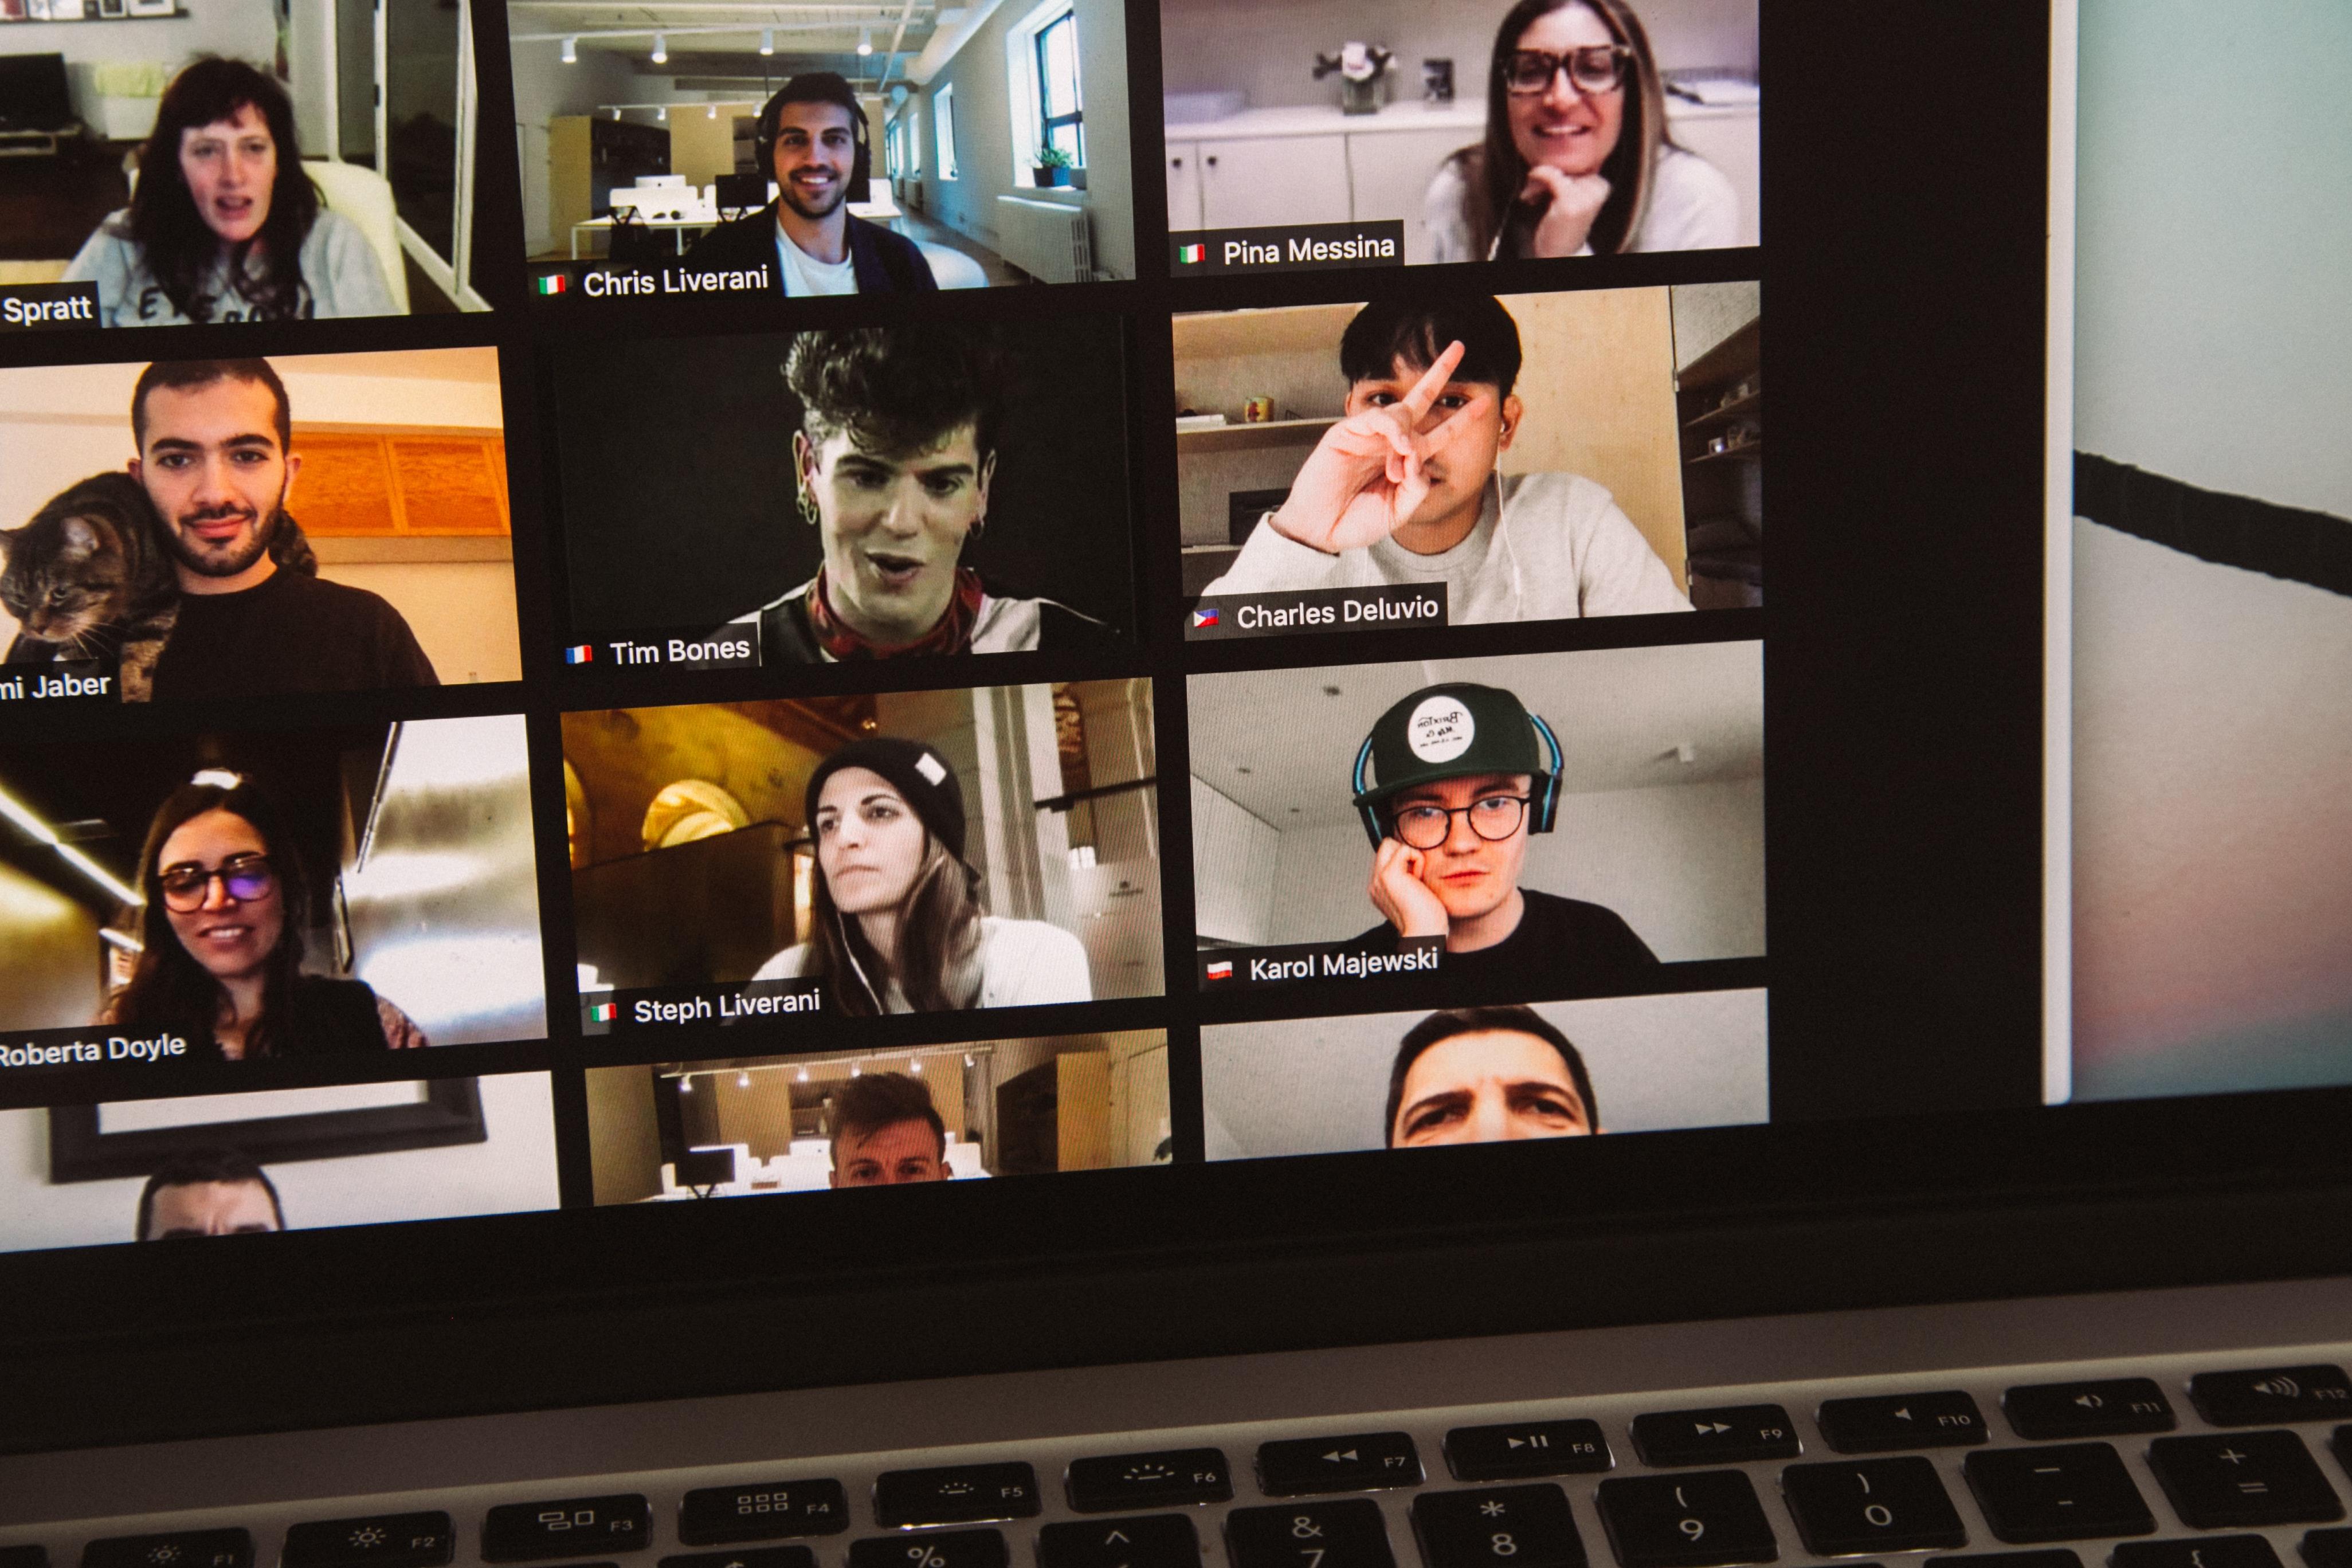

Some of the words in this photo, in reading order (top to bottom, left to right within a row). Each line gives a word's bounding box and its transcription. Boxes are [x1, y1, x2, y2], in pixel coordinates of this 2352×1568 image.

[1224, 240, 1280, 265] Pina
[1288, 234, 1395, 262] Messina
[583, 269, 656, 297] Chris
[663, 264, 769, 293] Liverani
[2, 296, 93, 327] Spratt
[1237, 602, 1335, 629] Charles
[1343, 595, 1438, 622] Deluvio
[609, 641, 660, 665] Tim
[668, 640, 750, 662] Bones
[31, 672, 111, 699] Jaber
[1251, 954, 1315, 981] Karol
[1323, 946, 1438, 978] Majewski
[634, 996, 712, 1025] Steph
[720, 988, 820, 1017] Liverani
[0, 1041, 101, 1067] Roberta
[107, 1033, 187, 1063] Doyle
[2314, 1388, 2346, 1400] F12
[2131, 1402, 2161, 1413] F11
[1938, 1415, 1971, 1426] F10
[1760, 1429, 1782, 1440] F9
[1572, 1443, 1595, 1453] F8
[1383, 1456, 1405, 1467] F7
[1193, 1472, 1216, 1483] F6
[1001, 1487, 1023, 1498] F5
[806, 1503, 829, 1514] F4
[1864, 1505, 1892, 1526] 0
[610, 1520, 633, 1531] F3
[1679, 1519, 1704, 1541] 9
[411, 1536, 435, 1548] F2
[1492, 1533, 1517, 1555] 8
[213, 1554, 234, 1566] F1
[907, 1546, 945, 1568] %
[1302, 1549, 1324, 1568] 7
